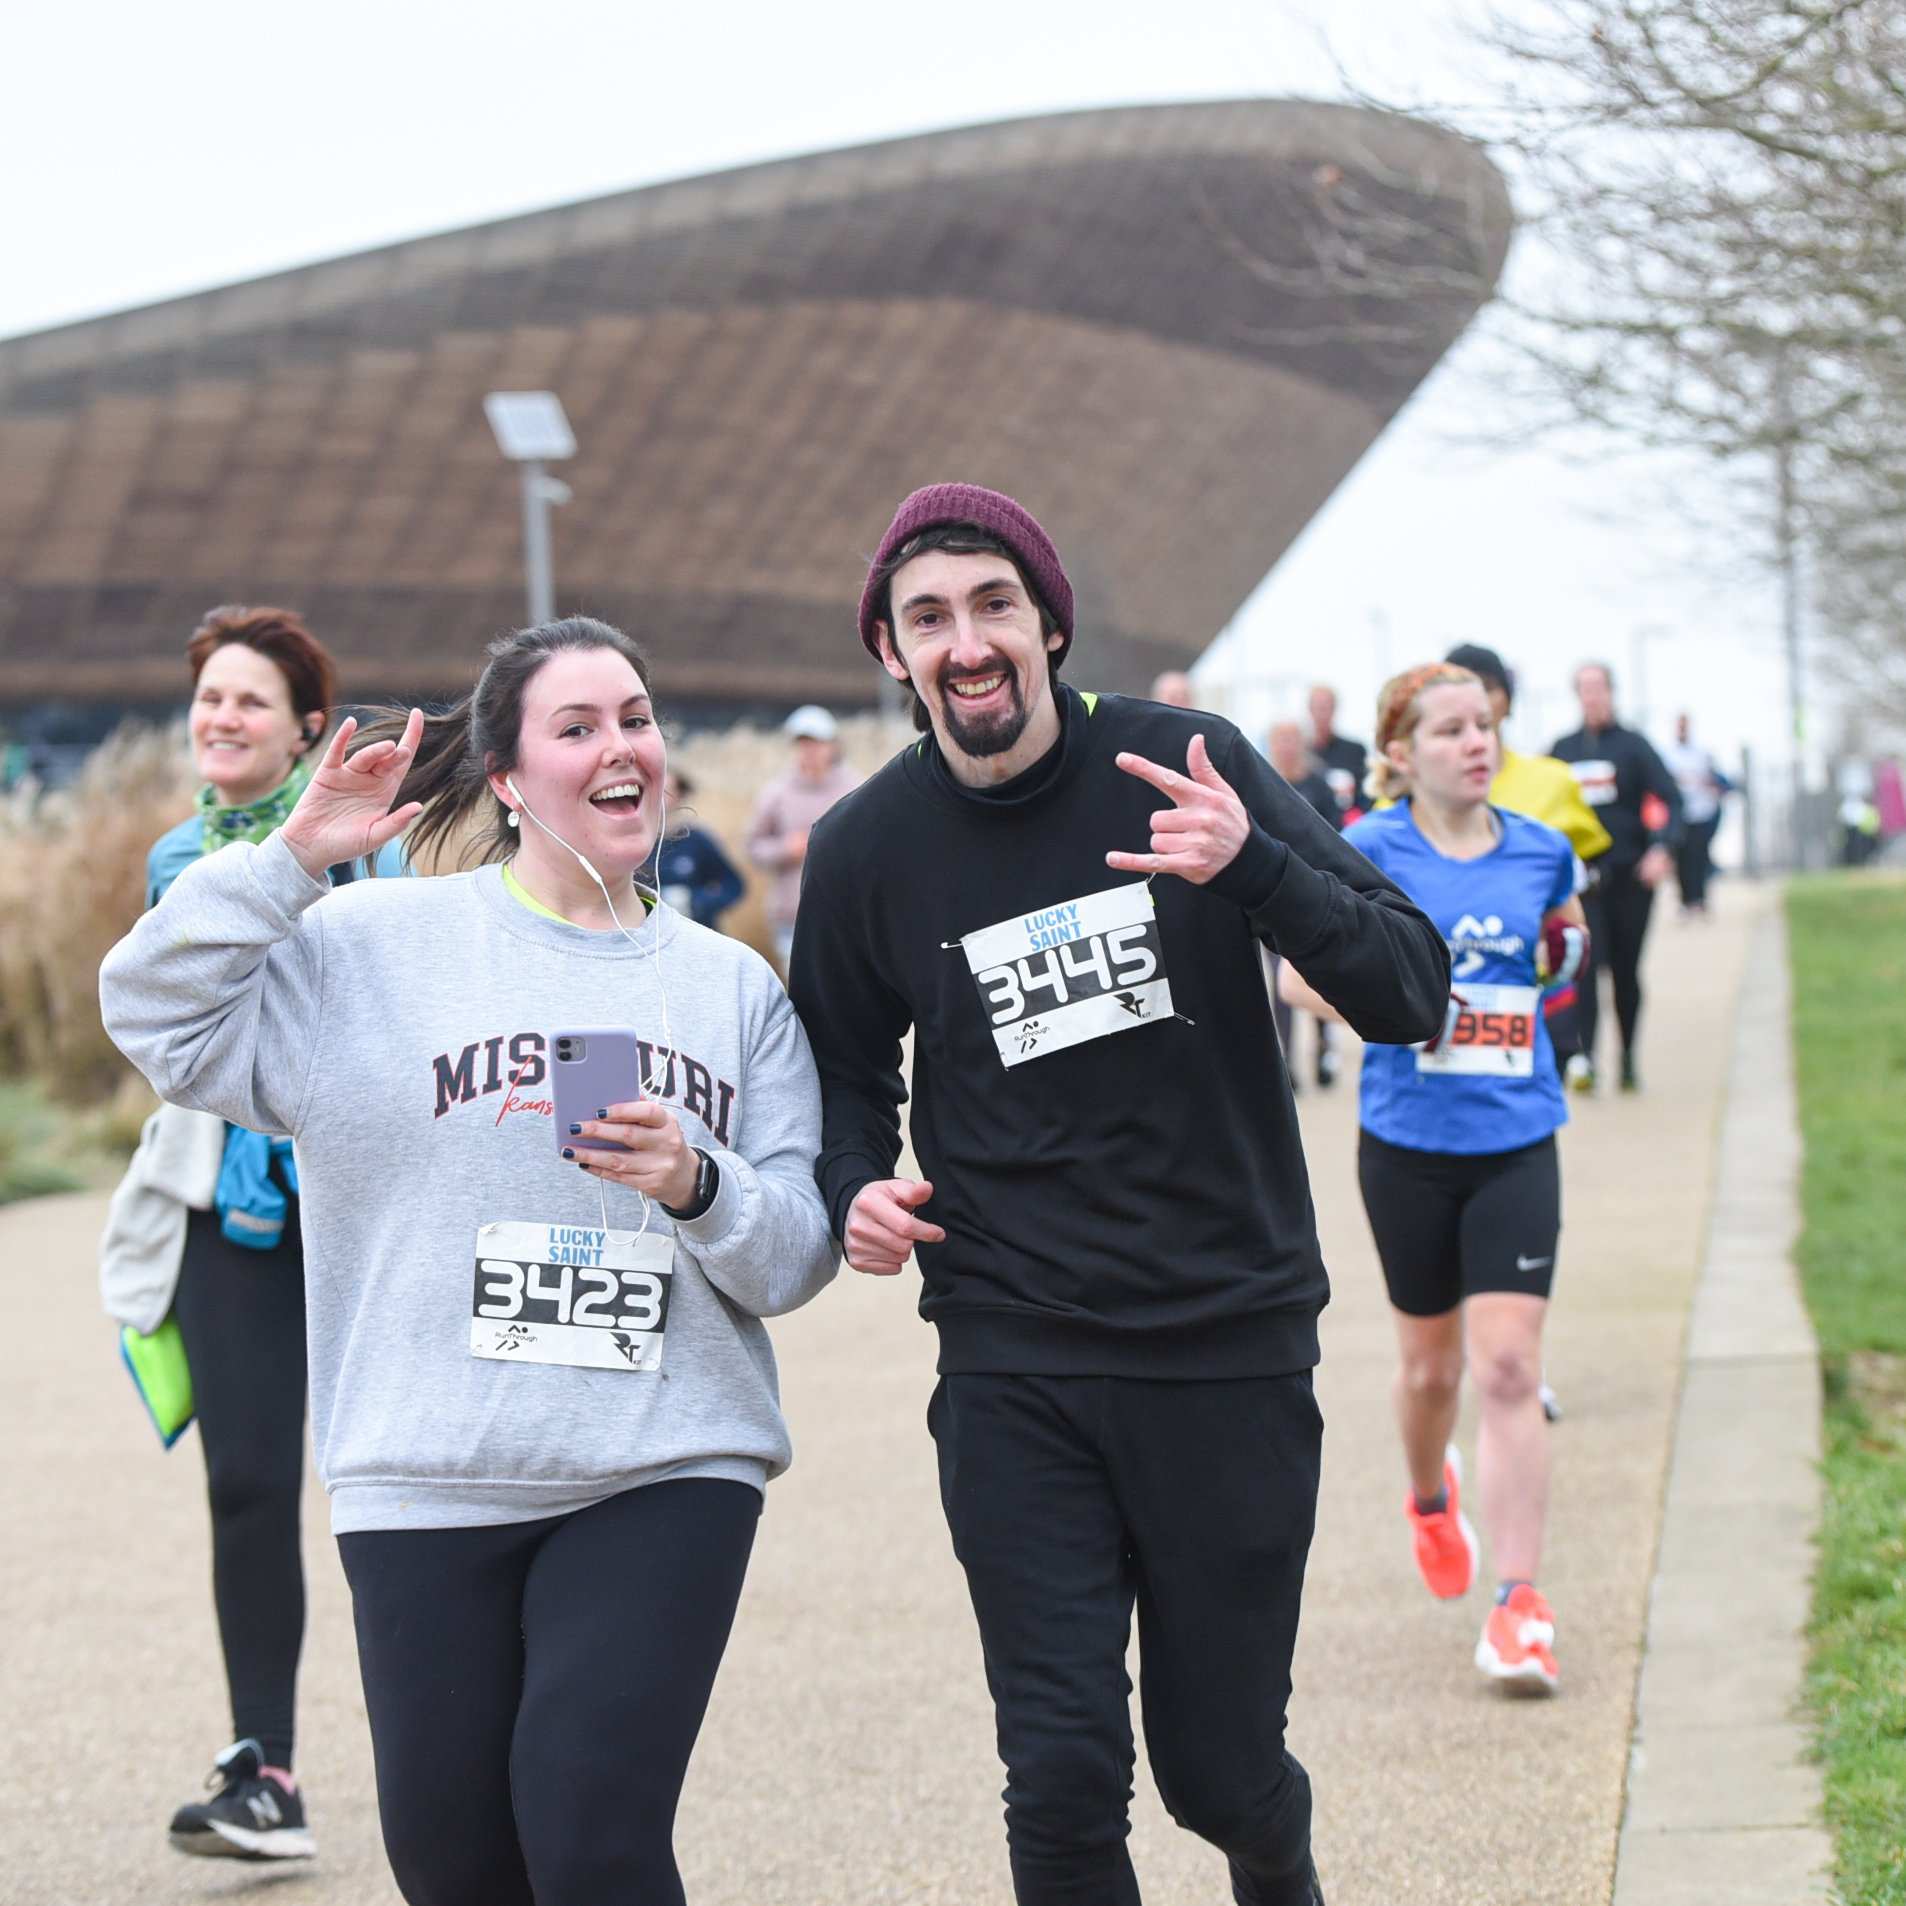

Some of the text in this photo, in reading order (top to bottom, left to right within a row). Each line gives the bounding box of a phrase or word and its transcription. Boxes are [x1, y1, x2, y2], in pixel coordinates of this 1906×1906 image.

[1024, 903, 1078, 933] LUCKY
[1030, 921, 1083, 952] SAINT
[977, 924, 1157, 1025] 3445
[432, 1032, 736, 1148] MISURI
[549, 1227, 607, 1248] LUCKY
[548, 1246, 604, 1266] SAINT
[478, 1260, 663, 1330] 3423
